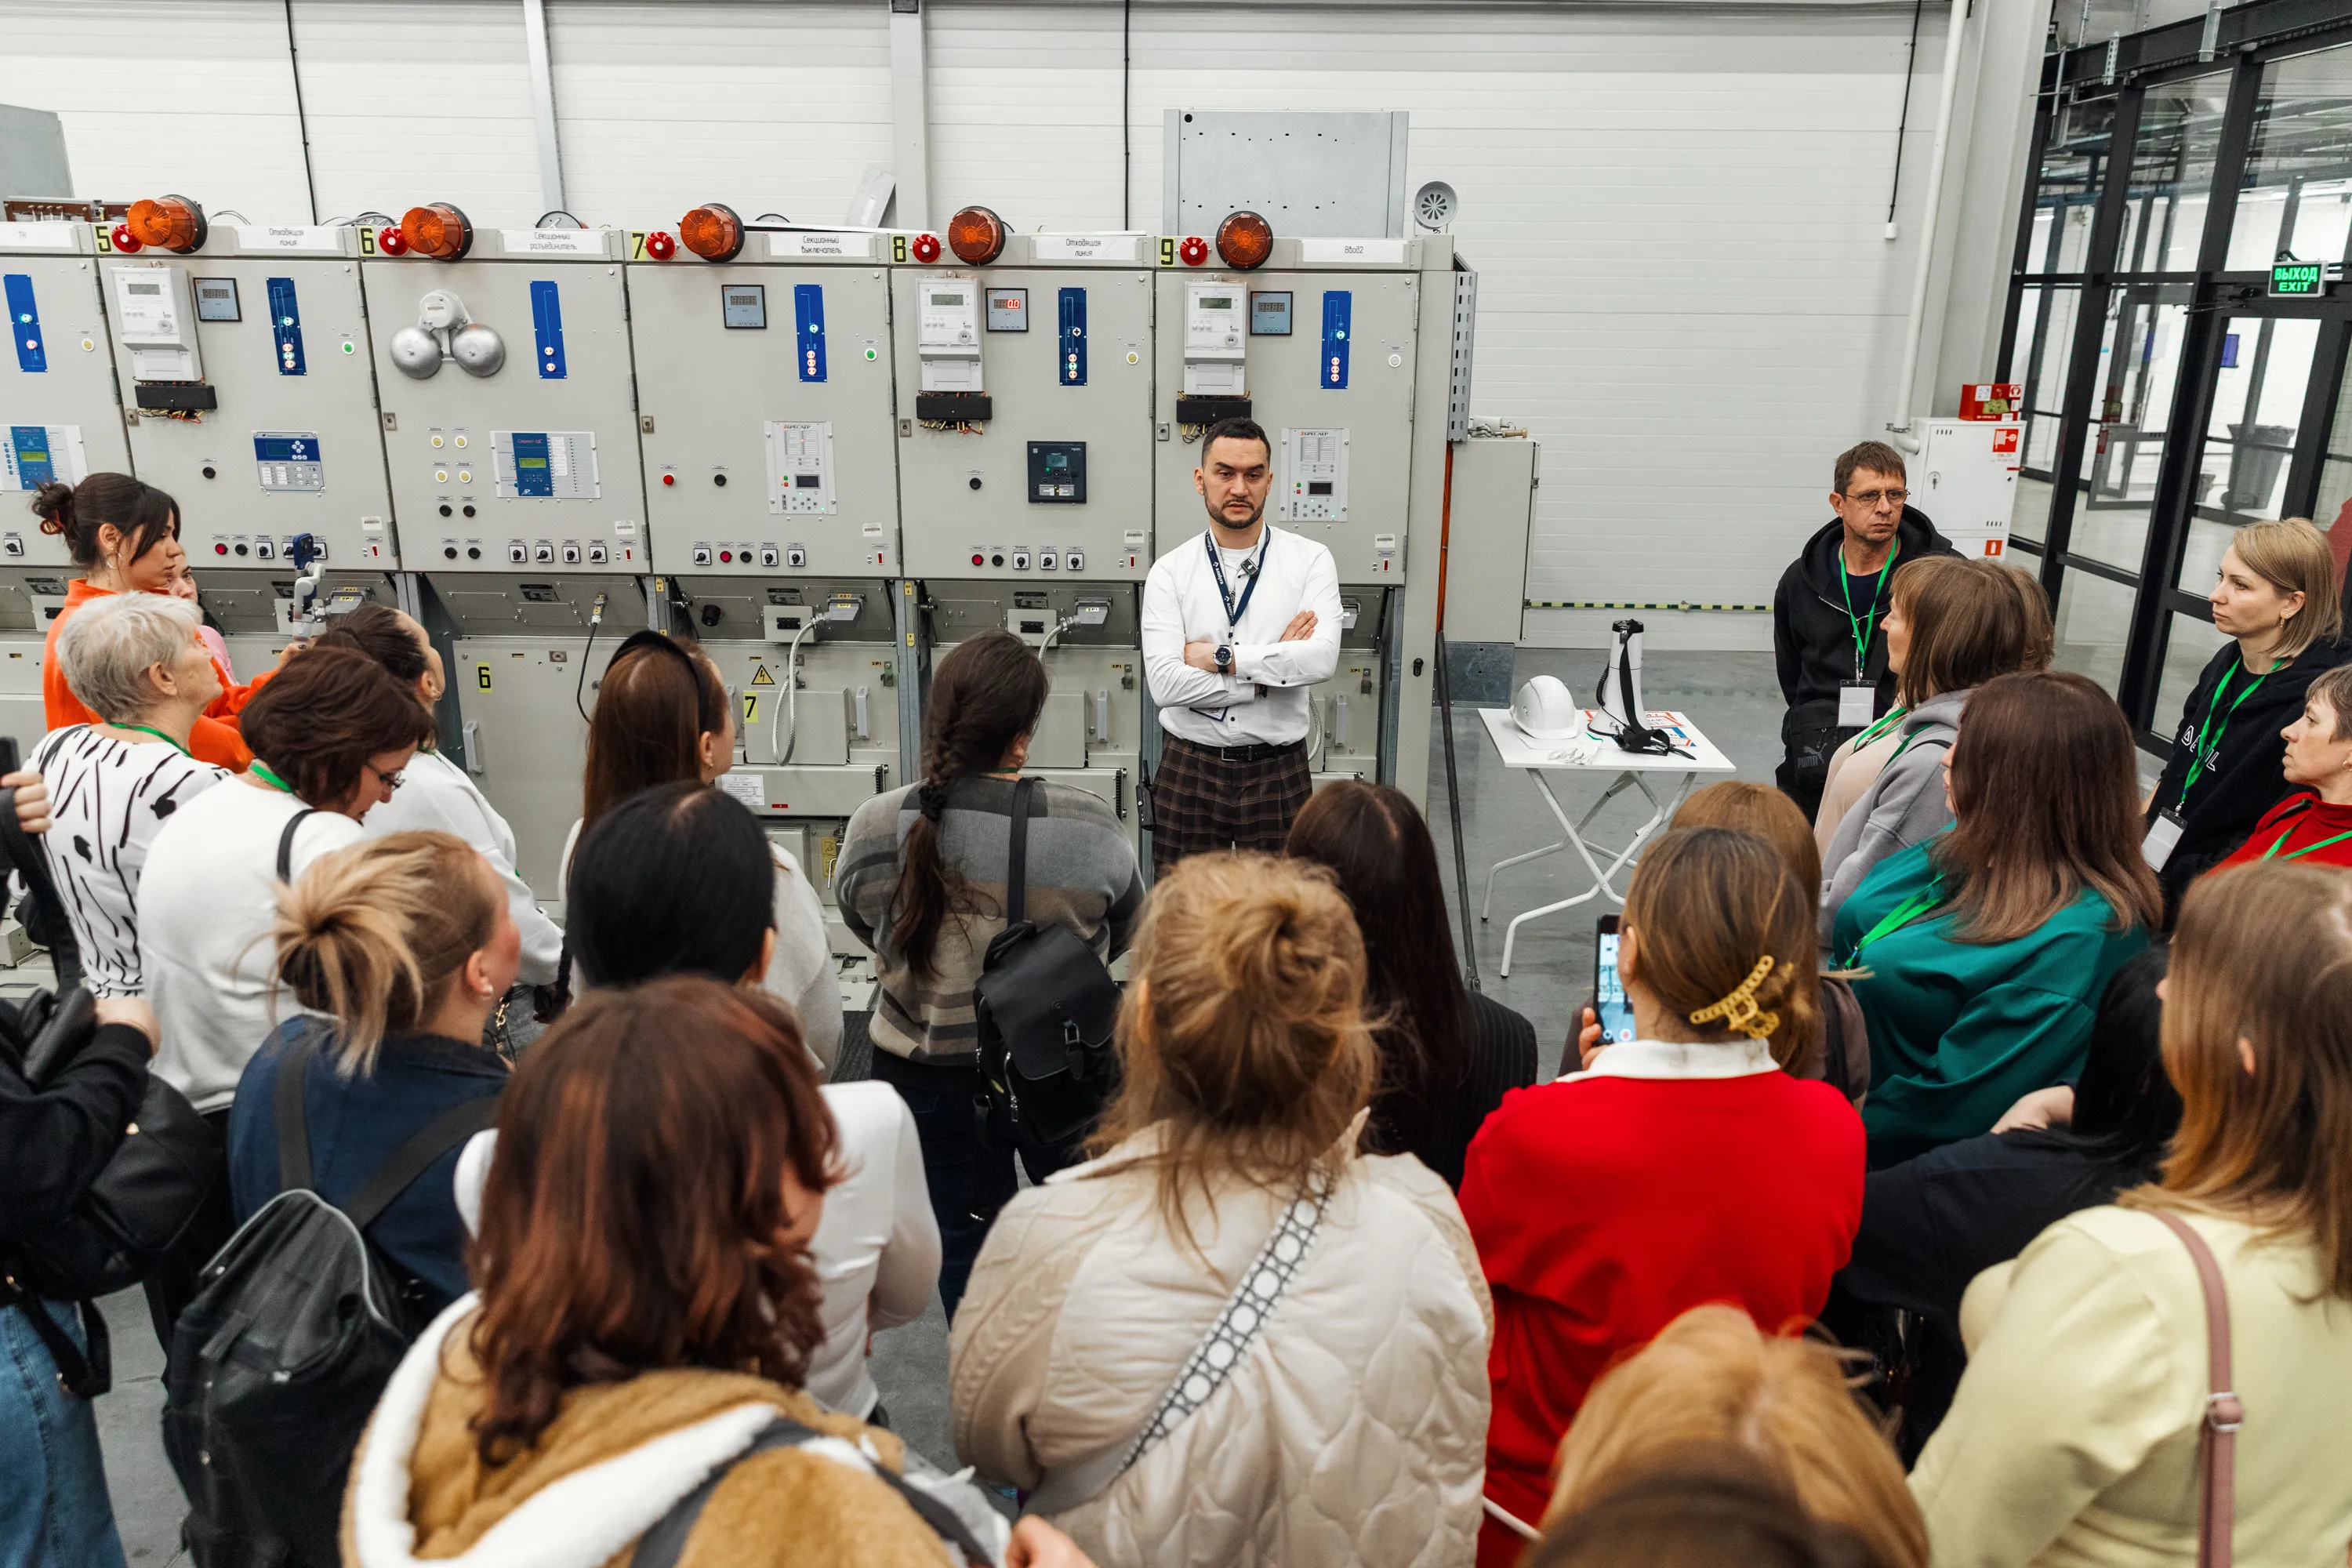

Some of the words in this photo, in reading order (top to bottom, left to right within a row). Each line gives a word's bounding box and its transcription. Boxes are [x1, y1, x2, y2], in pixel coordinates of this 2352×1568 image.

[95, 226, 111, 252] 5
[361, 228, 375, 254] 6
[534, 231, 571, 240] Секционный
[632, 233, 645, 260] 7
[803, 236, 839, 244] Секционный
[1065, 238, 1101, 247] Отходящая
[893, 236, 906, 263] 8
[1161, 239, 1174, 265] 9
[2274, 267, 2319, 283] ВЫХОД
[2278, 281, 2311, 292] EXIT
[478, 666, 492, 689] 6
[744, 696, 757, 719] 7
